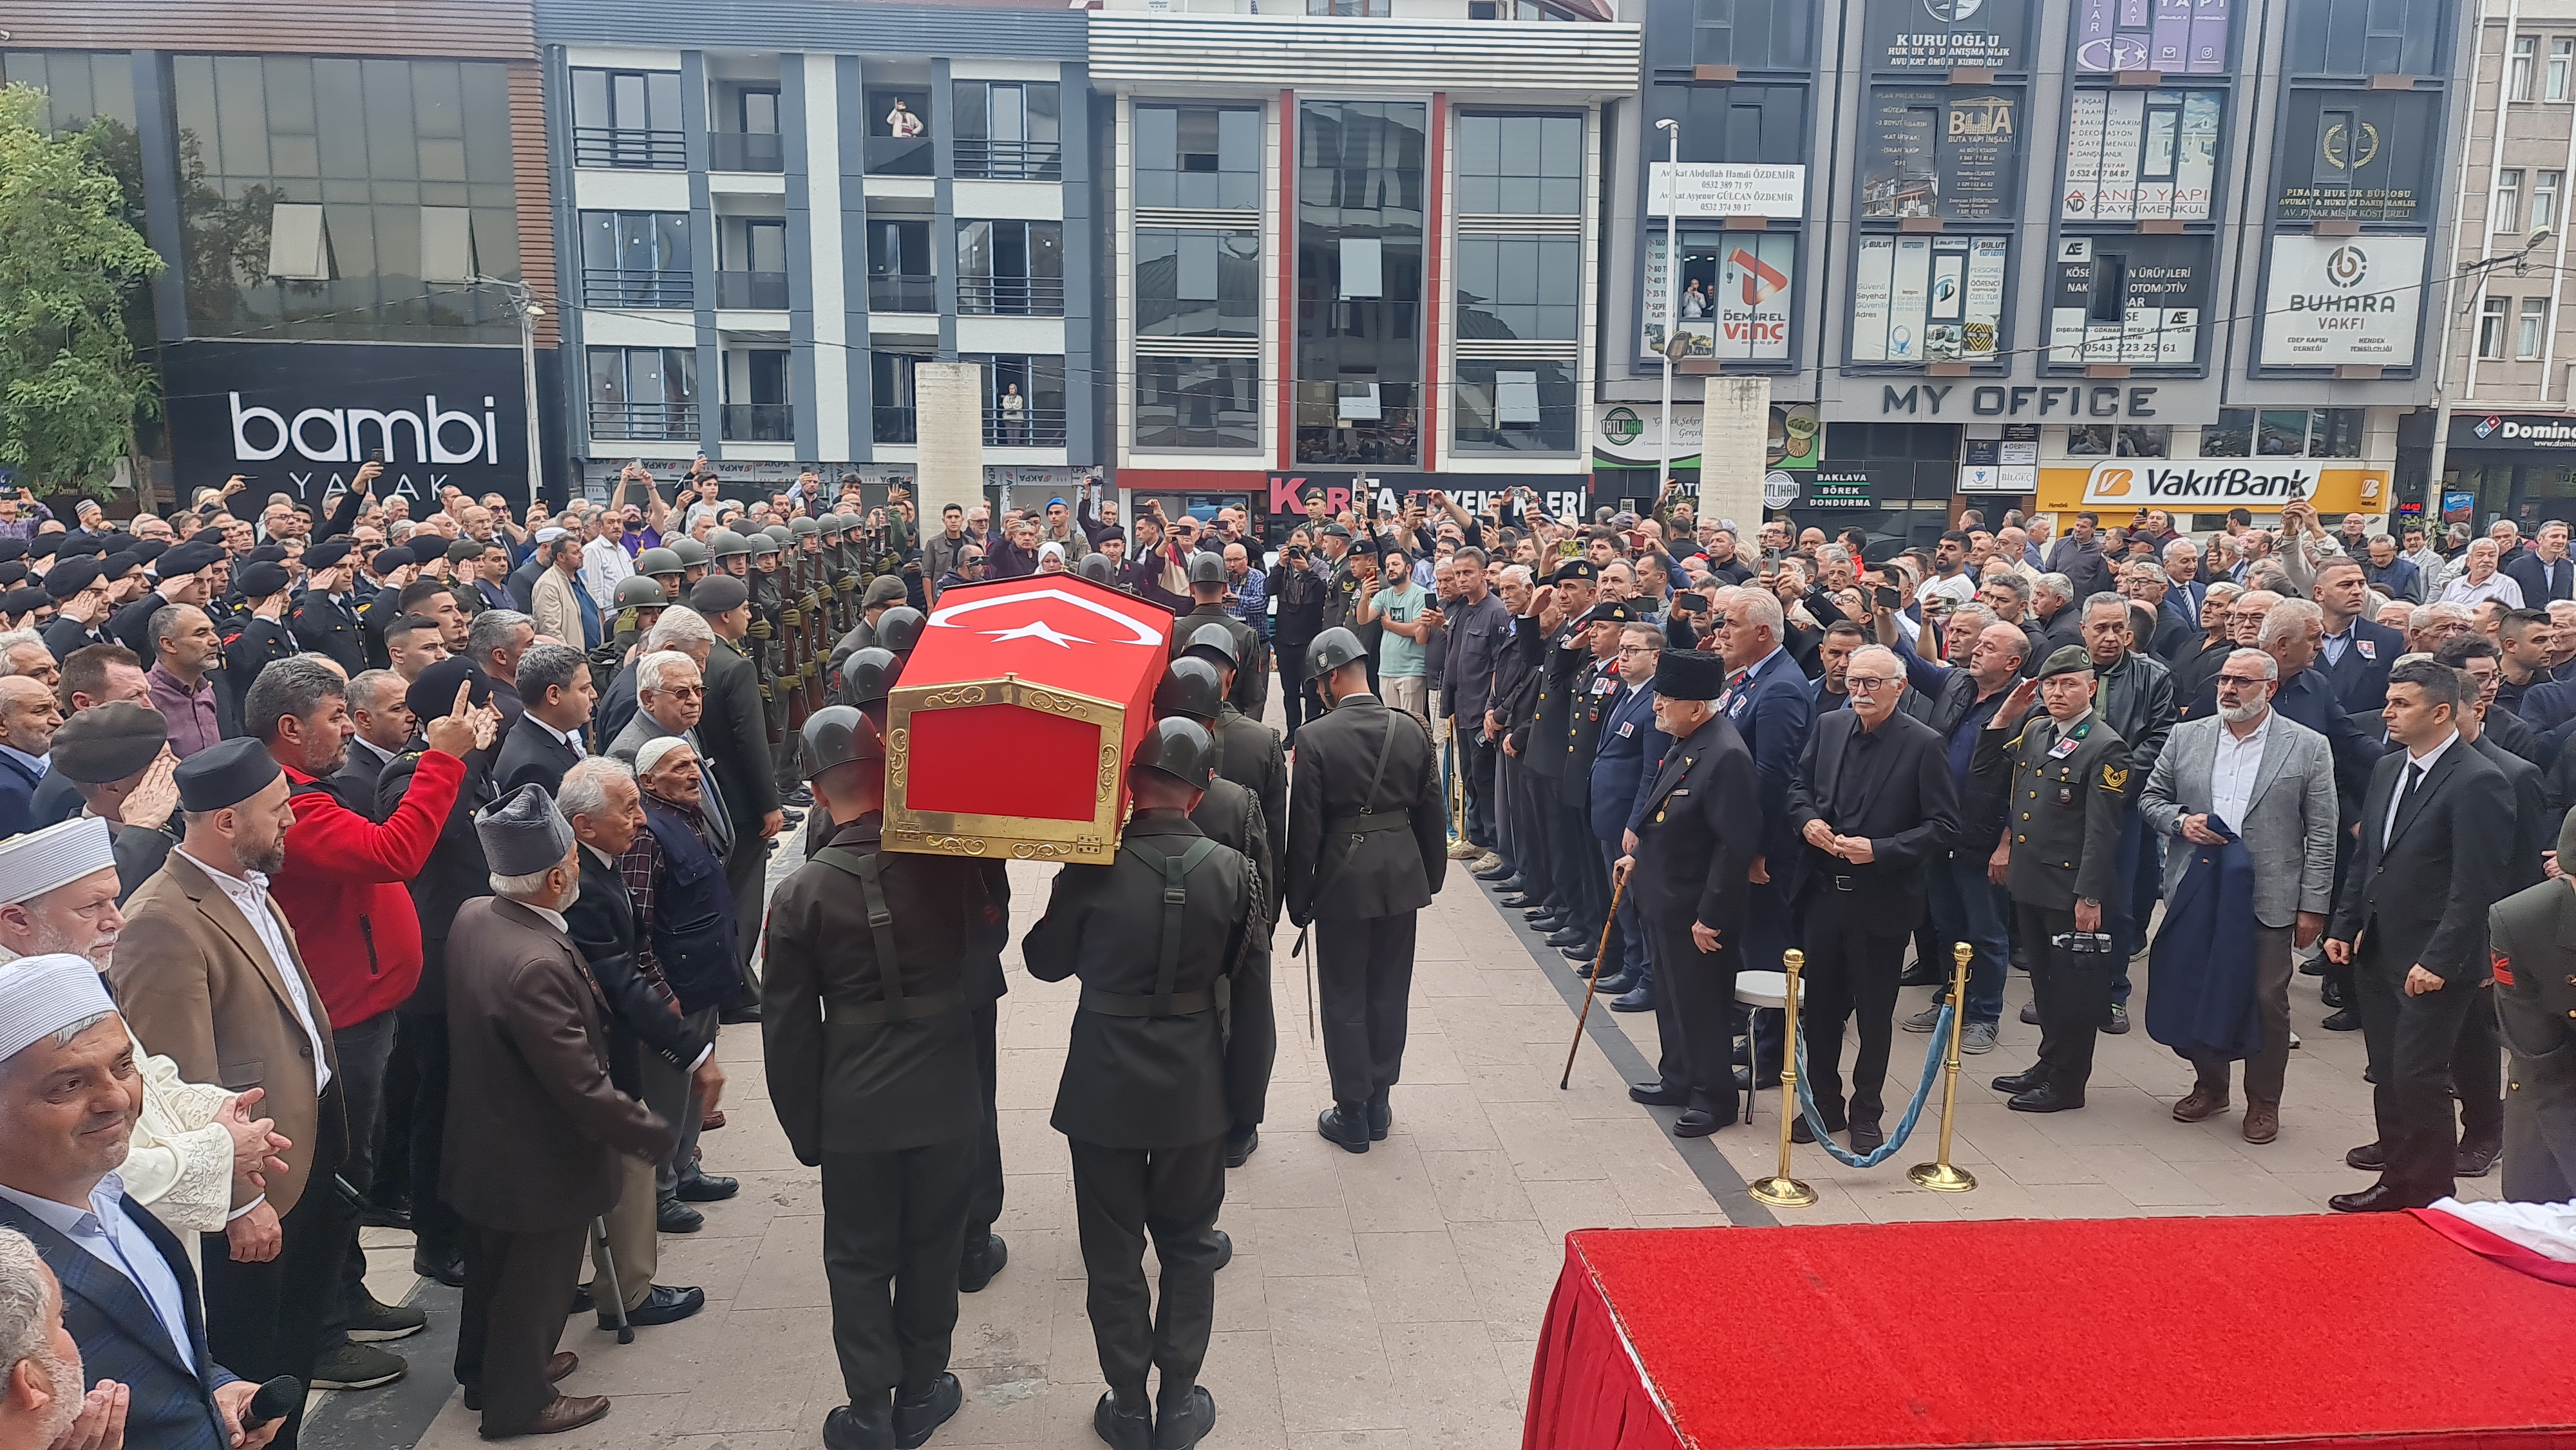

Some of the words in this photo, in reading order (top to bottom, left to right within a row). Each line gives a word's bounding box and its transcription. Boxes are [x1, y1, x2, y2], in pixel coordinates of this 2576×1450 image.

[1896, 33, 2000, 46] KURUOĞLU
[1689, 169, 1723, 178] Abdullah
[1754, 169, 1795, 179] ÖZDEMİR
[1754, 191, 1793, 201] ÖZDEMİR
[2157, 189, 2208, 201] YAPI
[2286, 188, 2320, 196] PINAR
[2290, 294, 2395, 313] BUHARA
[2318, 317, 2365, 330] VAKFI
[1884, 385, 1953, 413] MY
[1973, 386, 2157, 416] OFFICE
[229, 390, 498, 464] bambi
[1817, 473, 1867, 482] BAKLAVA
[2147, 468, 2313, 496] VakıfBank
[1823, 485, 1860, 494] BÖREK
[1271, 478, 1396, 515] KRFA
